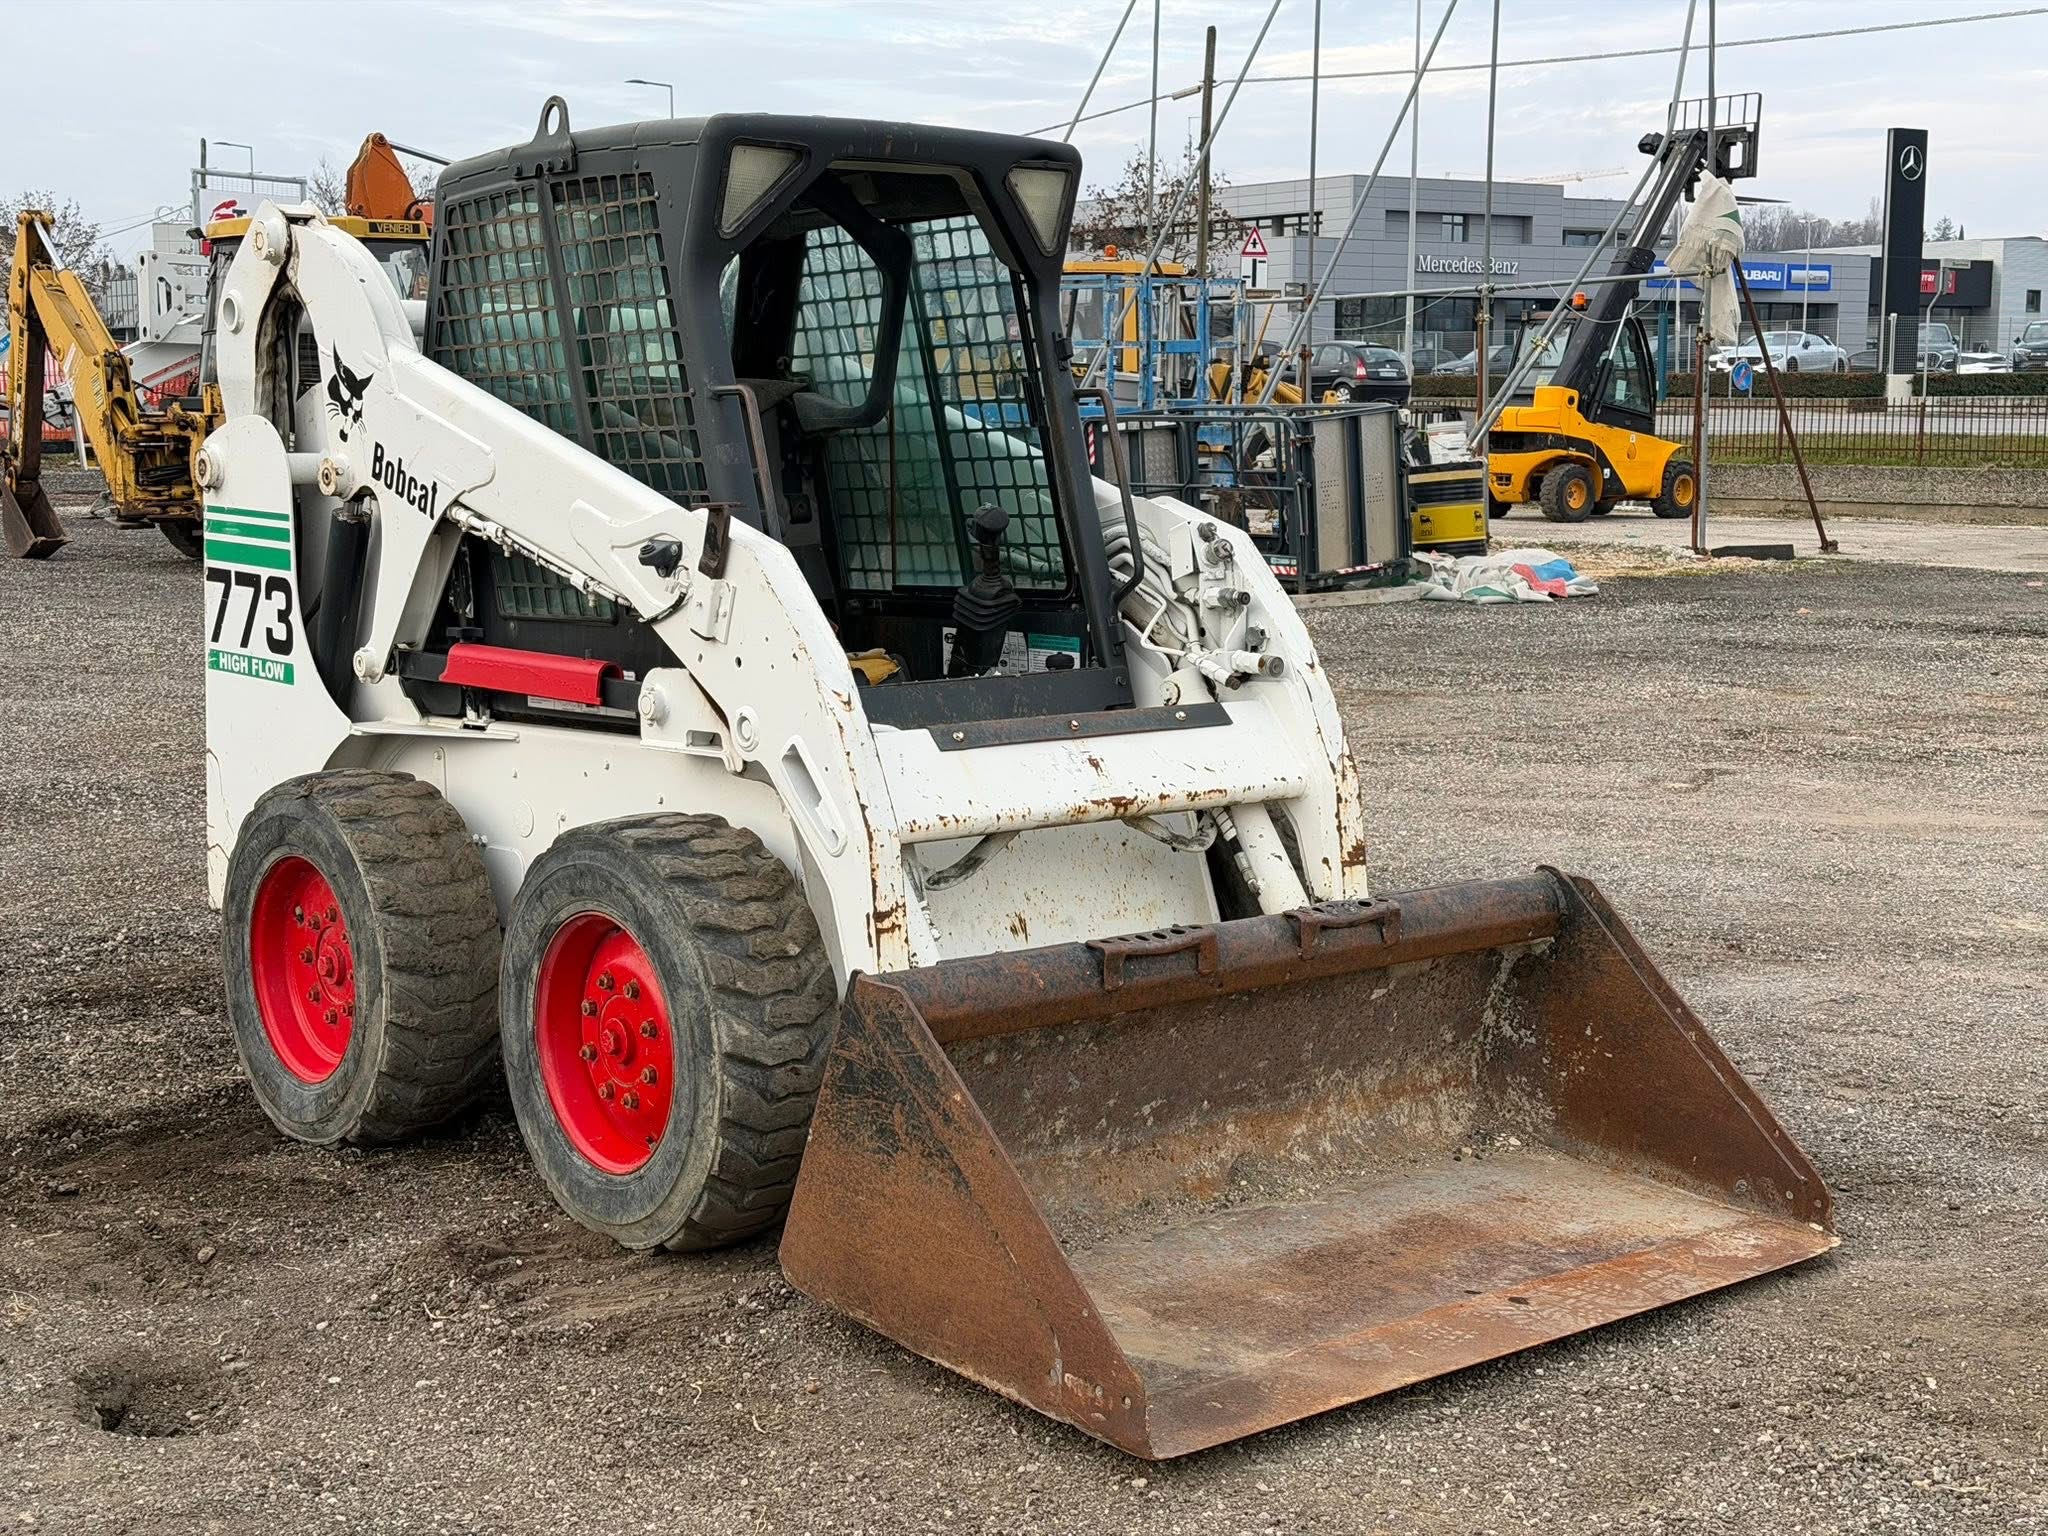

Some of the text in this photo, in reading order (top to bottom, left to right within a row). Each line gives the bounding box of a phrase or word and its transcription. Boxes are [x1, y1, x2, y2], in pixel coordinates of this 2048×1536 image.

[376, 223, 413, 233] VENIERI
[371, 440, 438, 521] Bobcat
[205, 566, 293, 657] 773
[219, 651, 285, 681] HIGH FLOW
